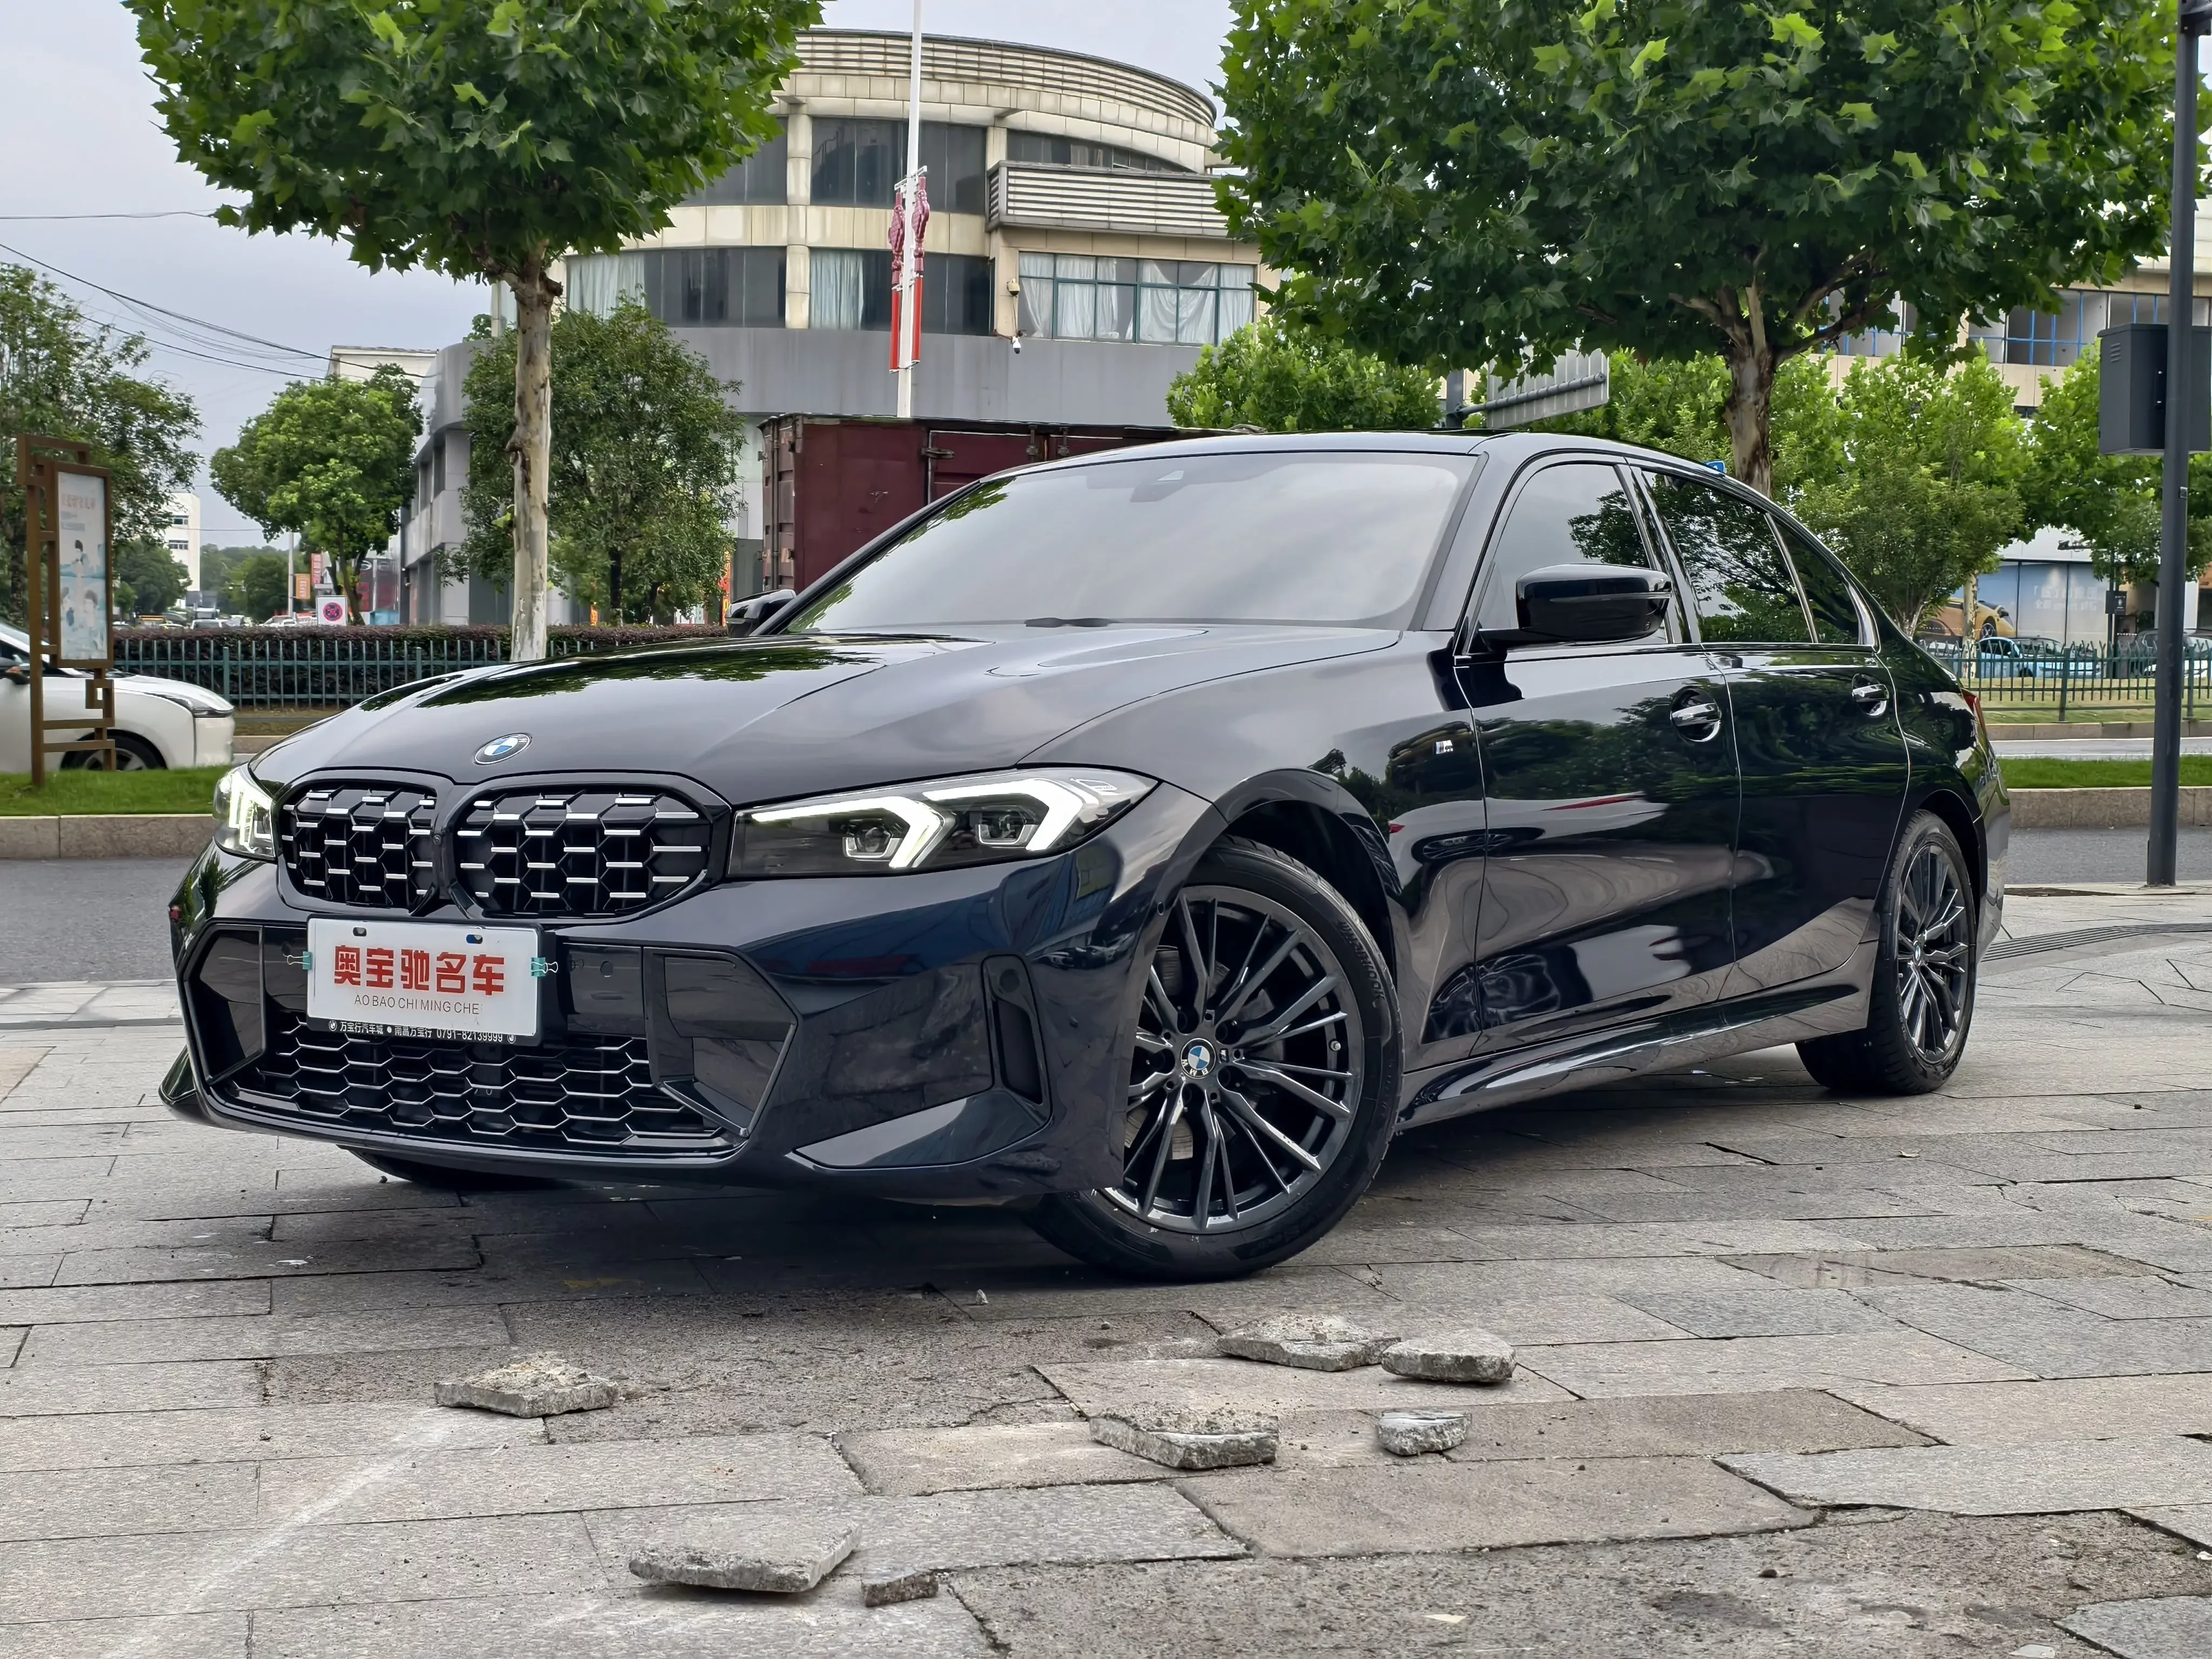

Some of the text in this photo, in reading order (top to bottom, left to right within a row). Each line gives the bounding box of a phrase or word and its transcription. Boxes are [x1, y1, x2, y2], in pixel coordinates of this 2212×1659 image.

[334, 945, 504, 996] 奥宝驰名车
[354, 994, 480, 1015] AO BAO CHI MING CHE
[436, 1029, 503, 1042] 0791-82139999
[1181, 1058, 1209, 1076] BMW
